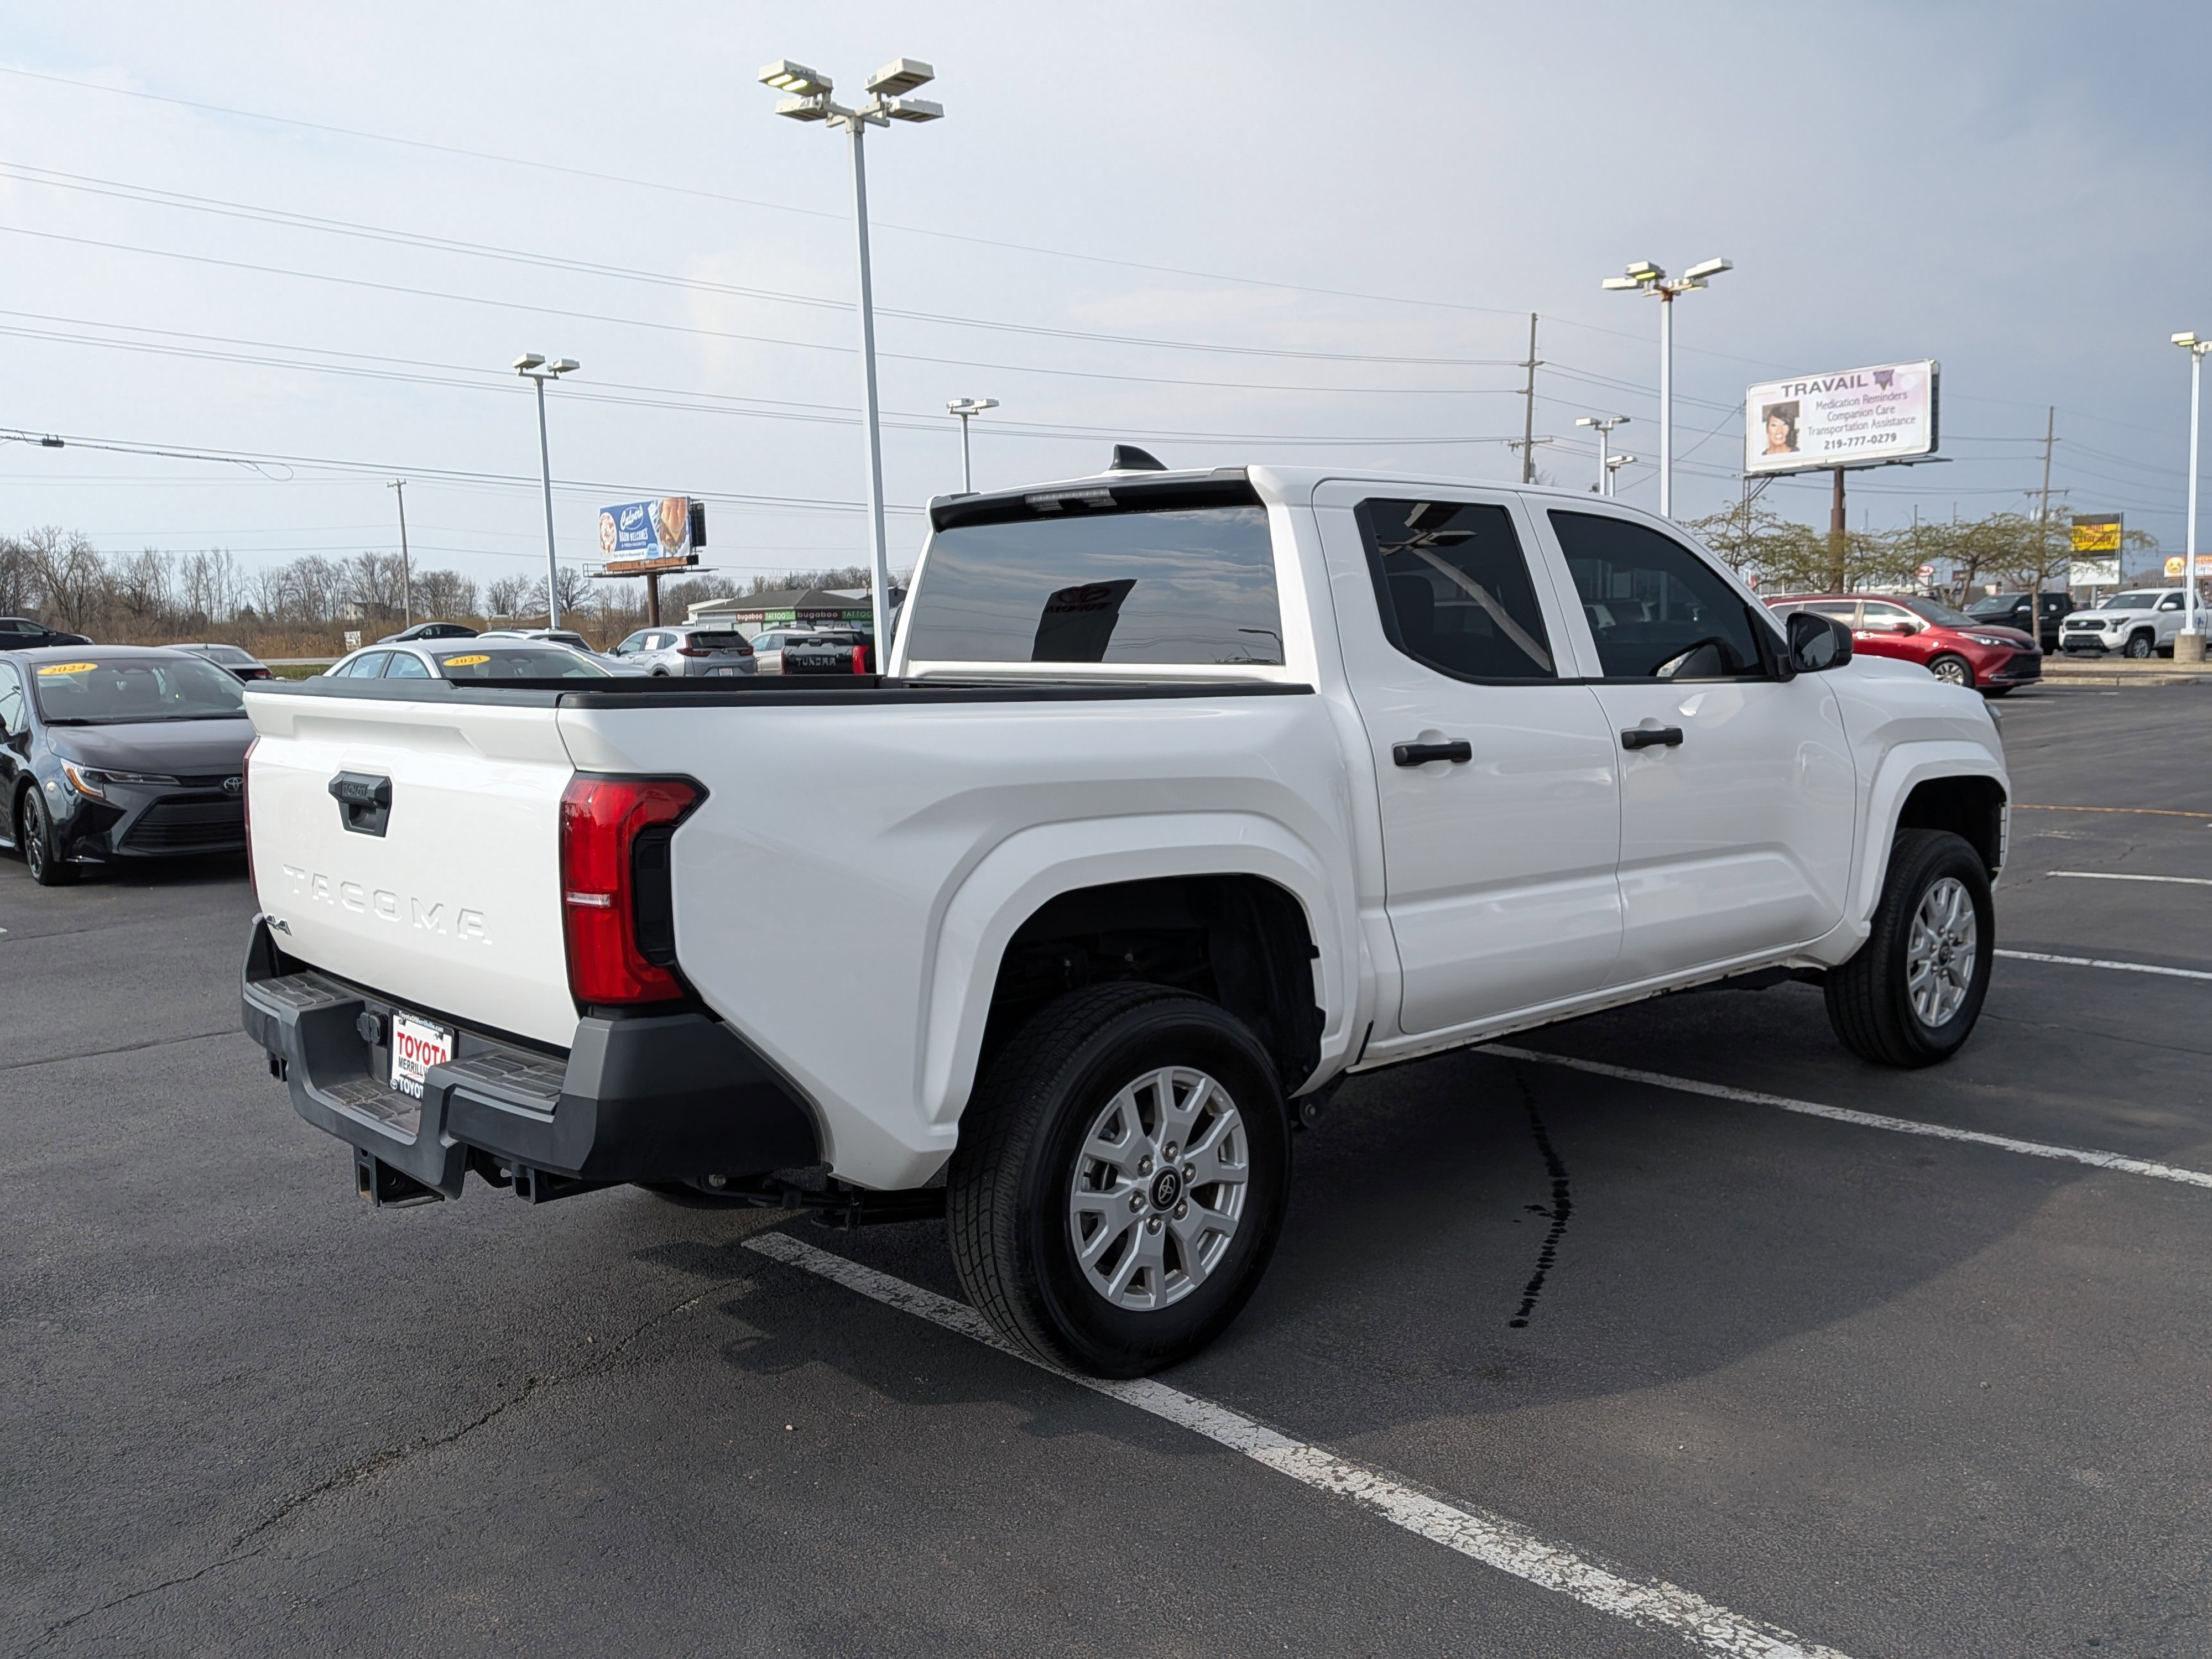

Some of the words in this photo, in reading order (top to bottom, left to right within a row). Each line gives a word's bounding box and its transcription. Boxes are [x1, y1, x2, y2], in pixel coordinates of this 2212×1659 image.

[1781, 374, 1869, 398] TRAVAIL
[1815, 397, 1860, 410] Medication
[1862, 391, 1908, 405] Reminders
[1827, 408, 1874, 421] Companion
[1875, 405, 1896, 416] Care
[1808, 420, 1870, 436] Transportation
[1870, 416, 1917, 429] Assistance
[1824, 432, 1897, 450] 219-777-0279
[737, 612, 763, 621] bugaboo
[797, 611, 838, 619] bugaboo
[795, 656, 836, 666] TUNDRA
[283, 864, 493, 945] TACOMA
[397, 1031, 447, 1065] TOYOTA
[398, 1056, 429, 1077] MERRILLV
[399, 1076, 424, 1099] TOYOT
